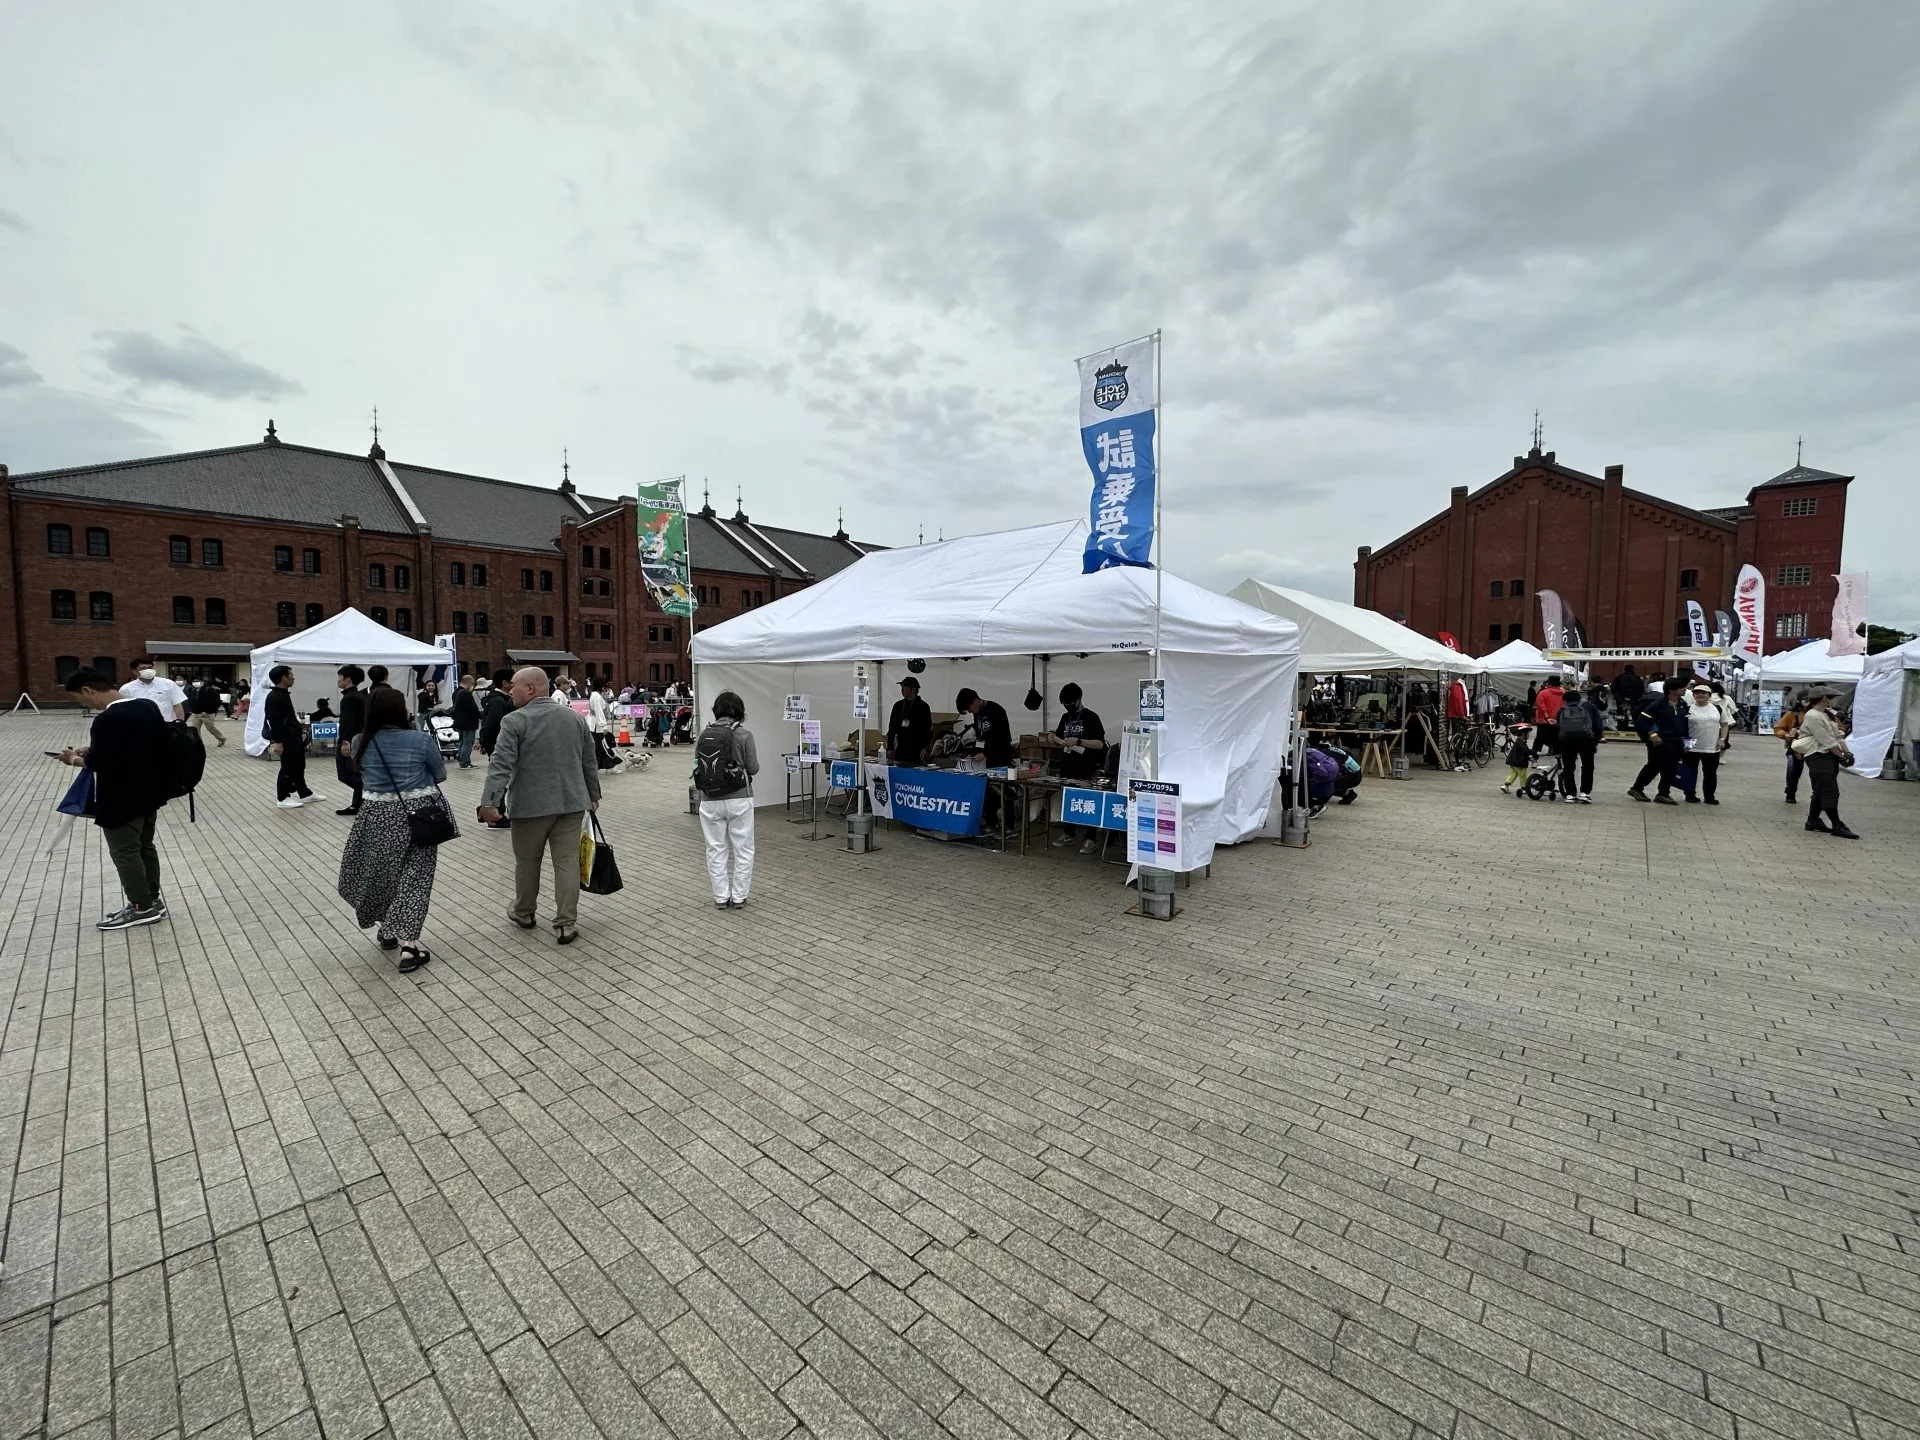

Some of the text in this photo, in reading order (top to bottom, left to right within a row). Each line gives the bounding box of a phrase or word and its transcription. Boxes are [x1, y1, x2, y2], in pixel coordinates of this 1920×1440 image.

[314, 727, 337, 735] KIDS
[836, 774, 851, 786] 受付
[894, 782, 925, 794] YOKOHAMA
[1134, 781, 1174, 793] ステージプログラム
[895, 791, 971, 816] CYCLESTYLE
[1070, 798, 1128, 818] 試乗 受
